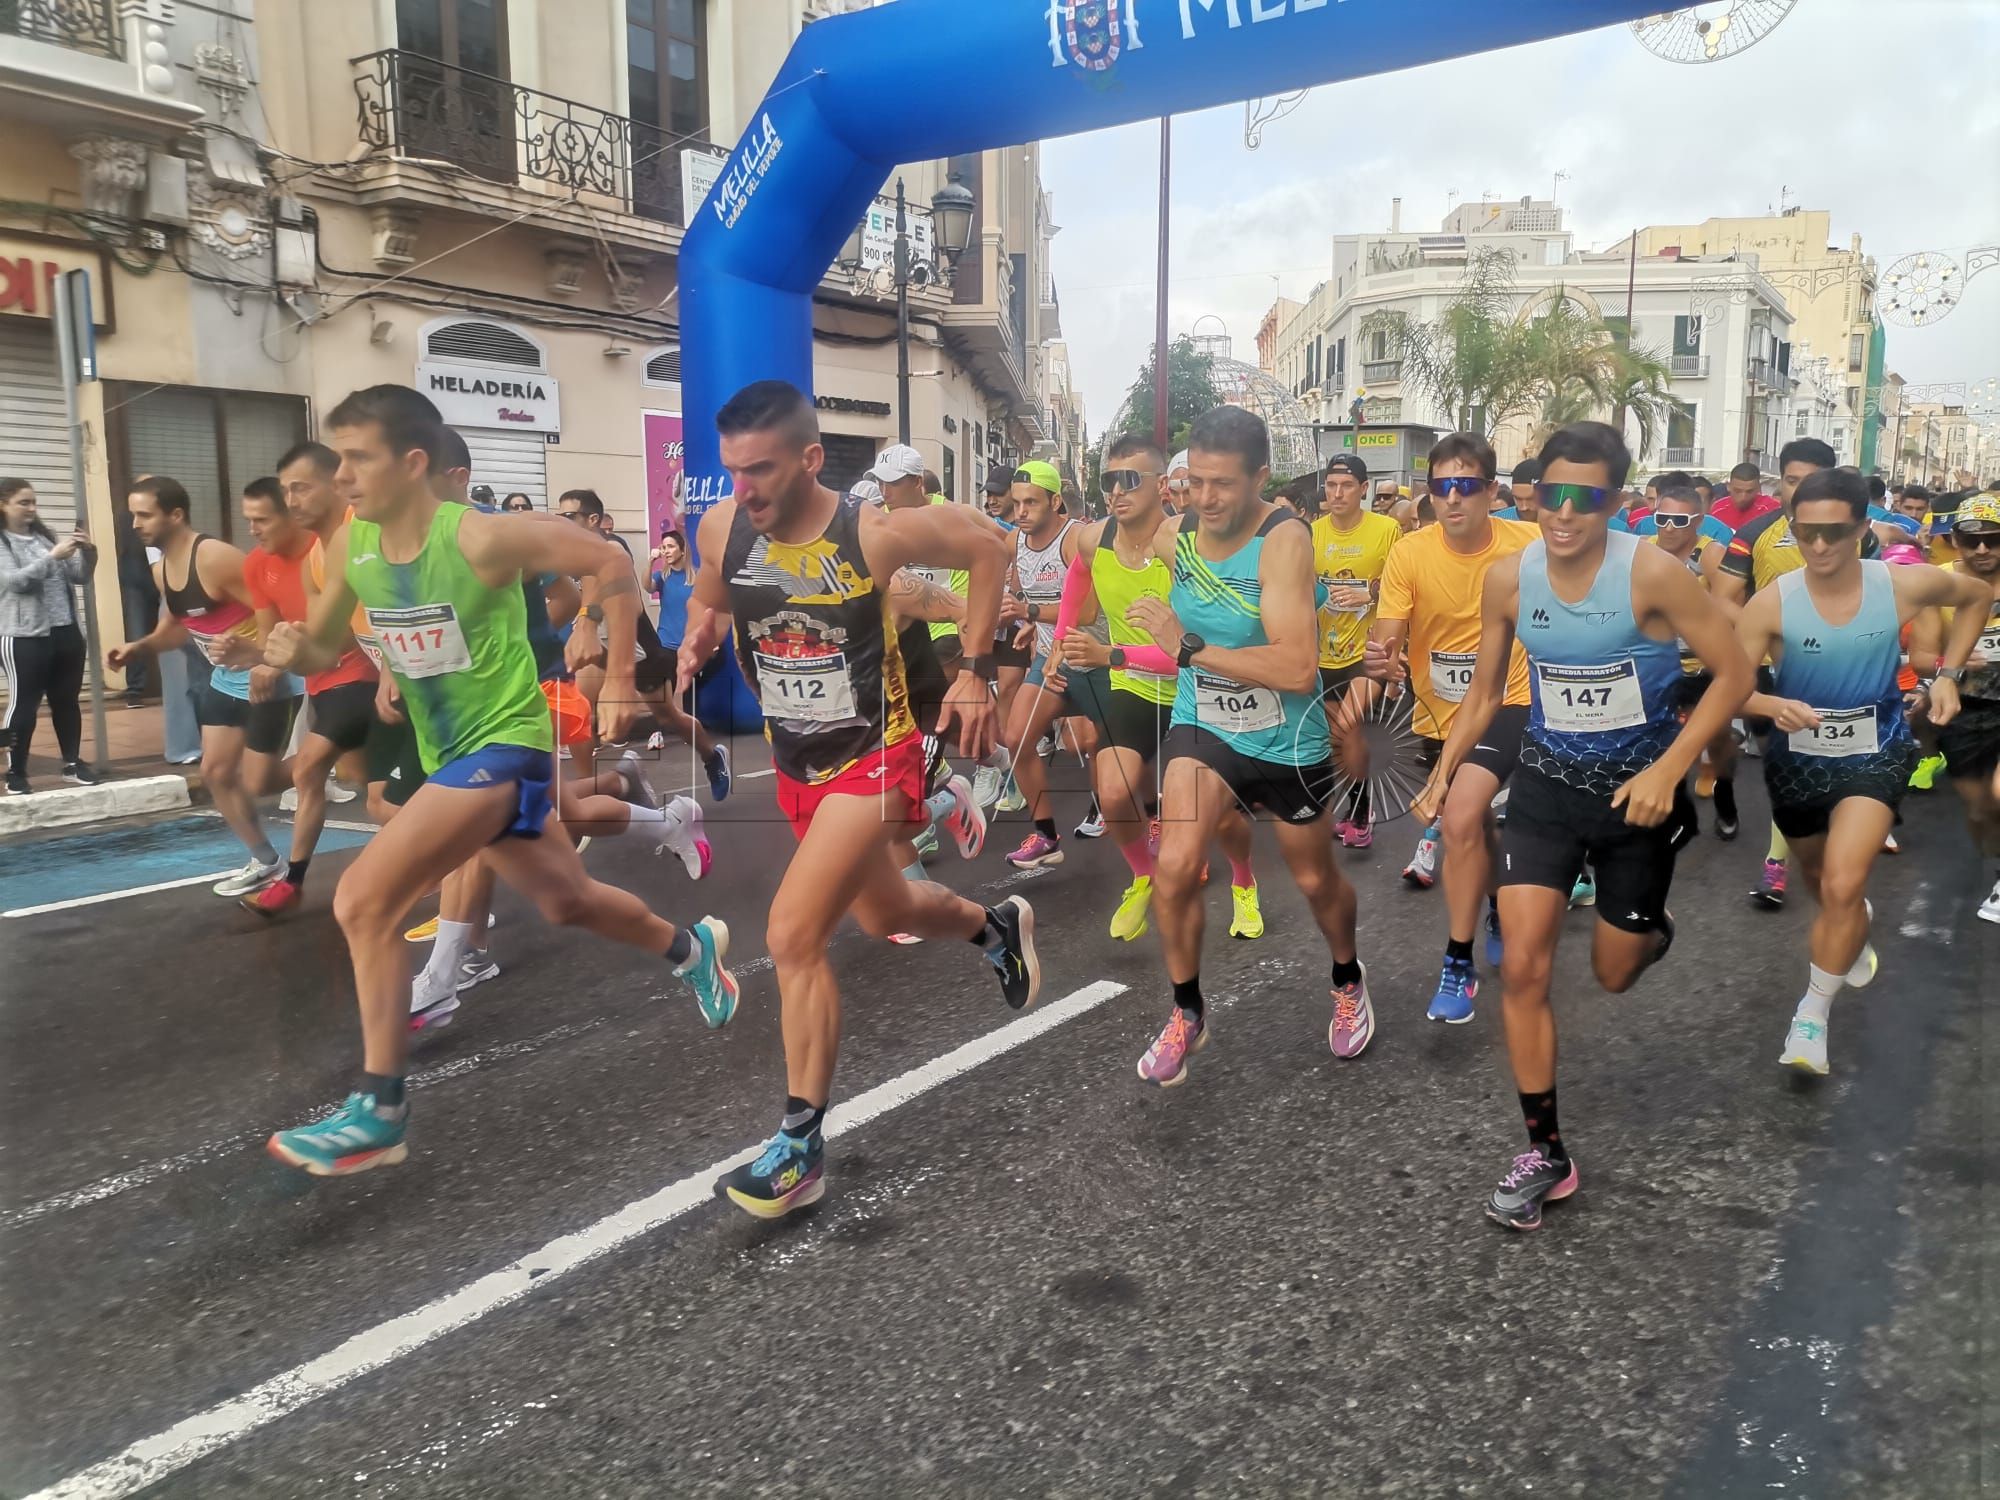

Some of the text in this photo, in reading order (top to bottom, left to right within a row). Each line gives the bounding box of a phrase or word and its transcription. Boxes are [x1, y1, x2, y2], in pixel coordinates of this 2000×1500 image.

[713, 112, 776, 221] MELILLA
[864, 246, 880, 261] 900
[430, 374, 546, 401] HELADERÍA
[1359, 434, 1393, 445] ONCE
[383, 628, 444, 653] 1117
[1446, 669, 1473, 685] 10
[1558, 667, 1582, 676] MEDIA
[1582, 665, 1622, 676] MARATÓN
[777, 678, 826, 700] 112
[1560, 687, 1612, 707] 147
[1214, 694, 1259, 713] 104
[1808, 725, 1856, 740] 134
